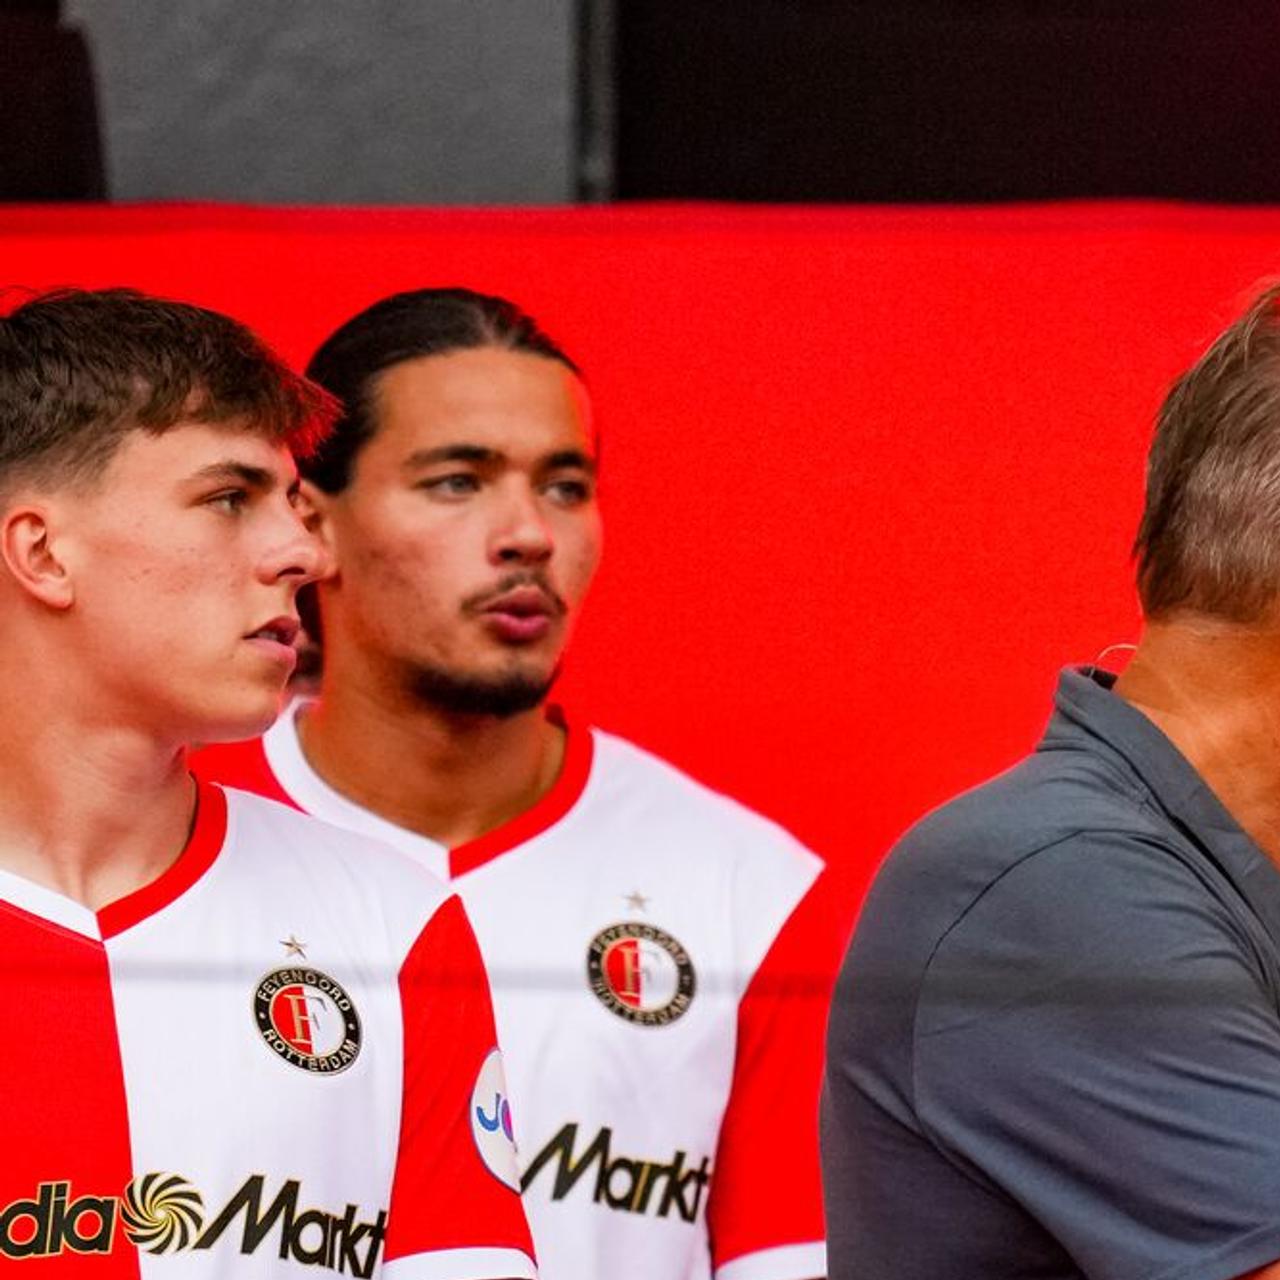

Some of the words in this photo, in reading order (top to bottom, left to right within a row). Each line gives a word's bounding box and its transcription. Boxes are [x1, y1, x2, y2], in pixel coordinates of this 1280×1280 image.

[256, 969, 351, 1012] FEYENOORD
[262, 1029, 359, 1071] ROTTERDAM
[520, 1122, 710, 1224] Markt
[191, 1174, 387, 1280] Markt
